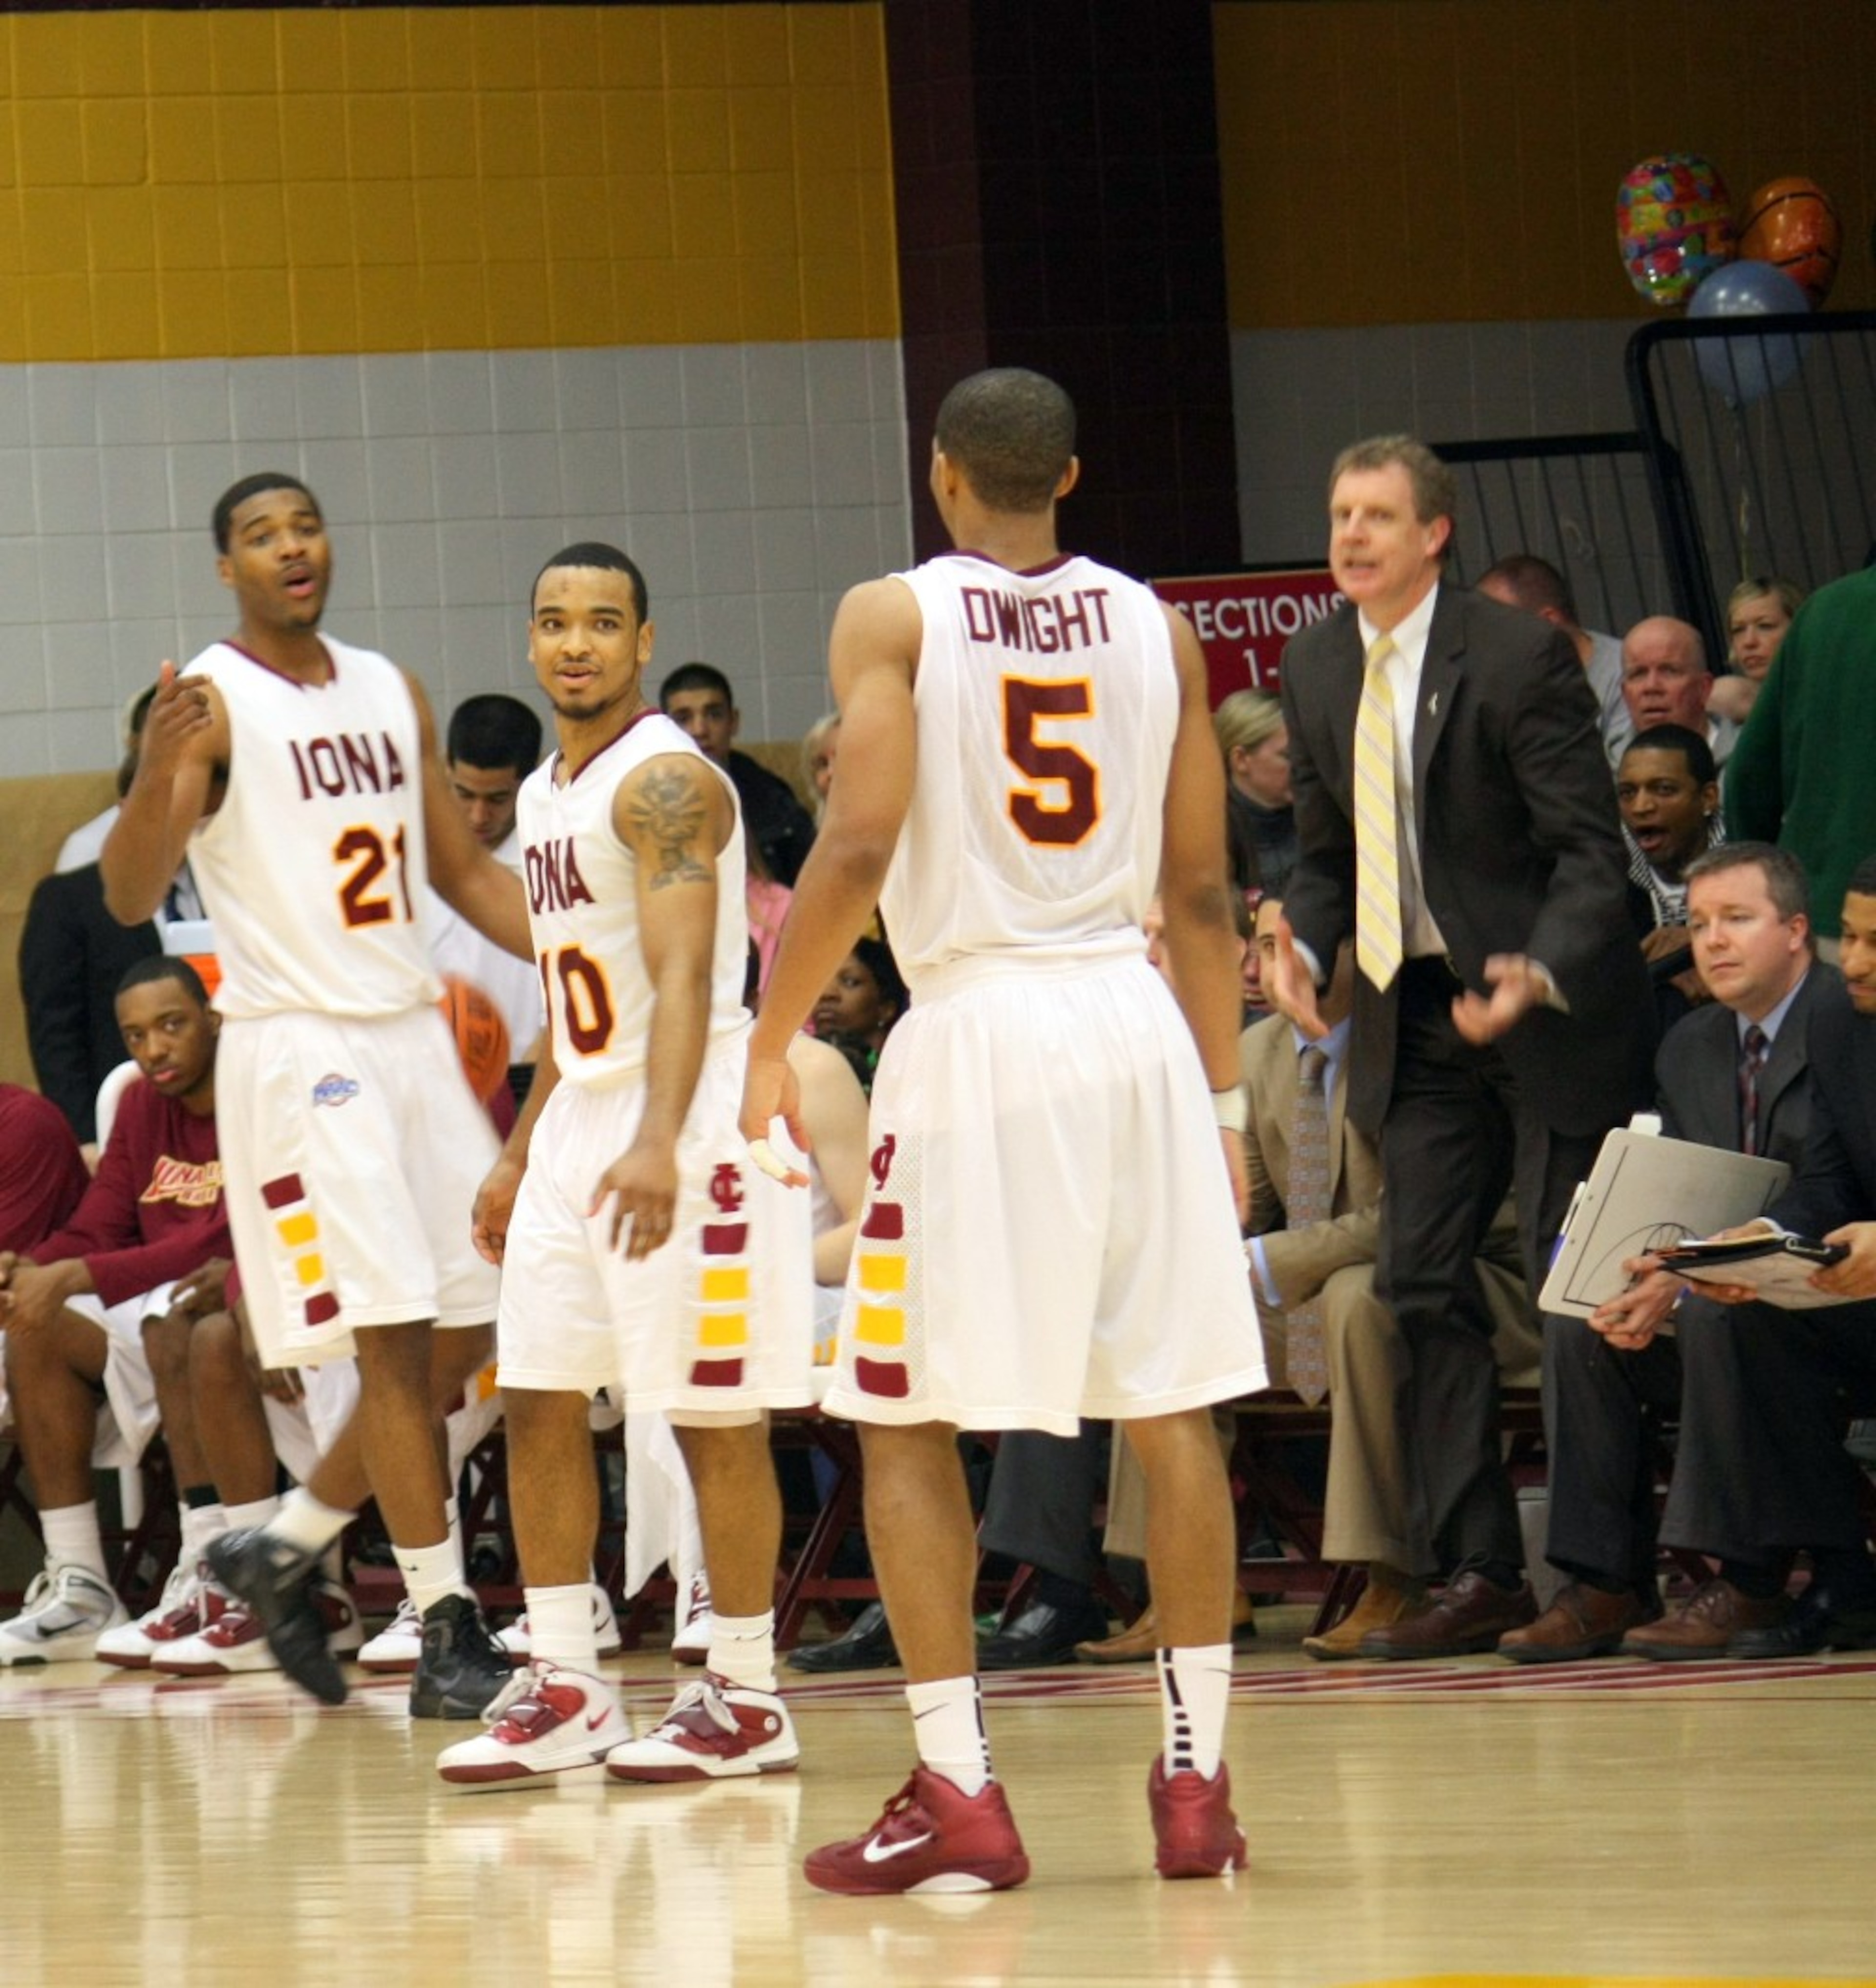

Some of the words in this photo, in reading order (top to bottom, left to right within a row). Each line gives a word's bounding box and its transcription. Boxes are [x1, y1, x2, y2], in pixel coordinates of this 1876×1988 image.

[961, 586, 1110, 653] DWIGHT
[289, 731, 404, 800] IONA
[1000, 673, 1102, 850] 5
[332, 822, 414, 930] 21
[524, 836, 596, 915] ONA
